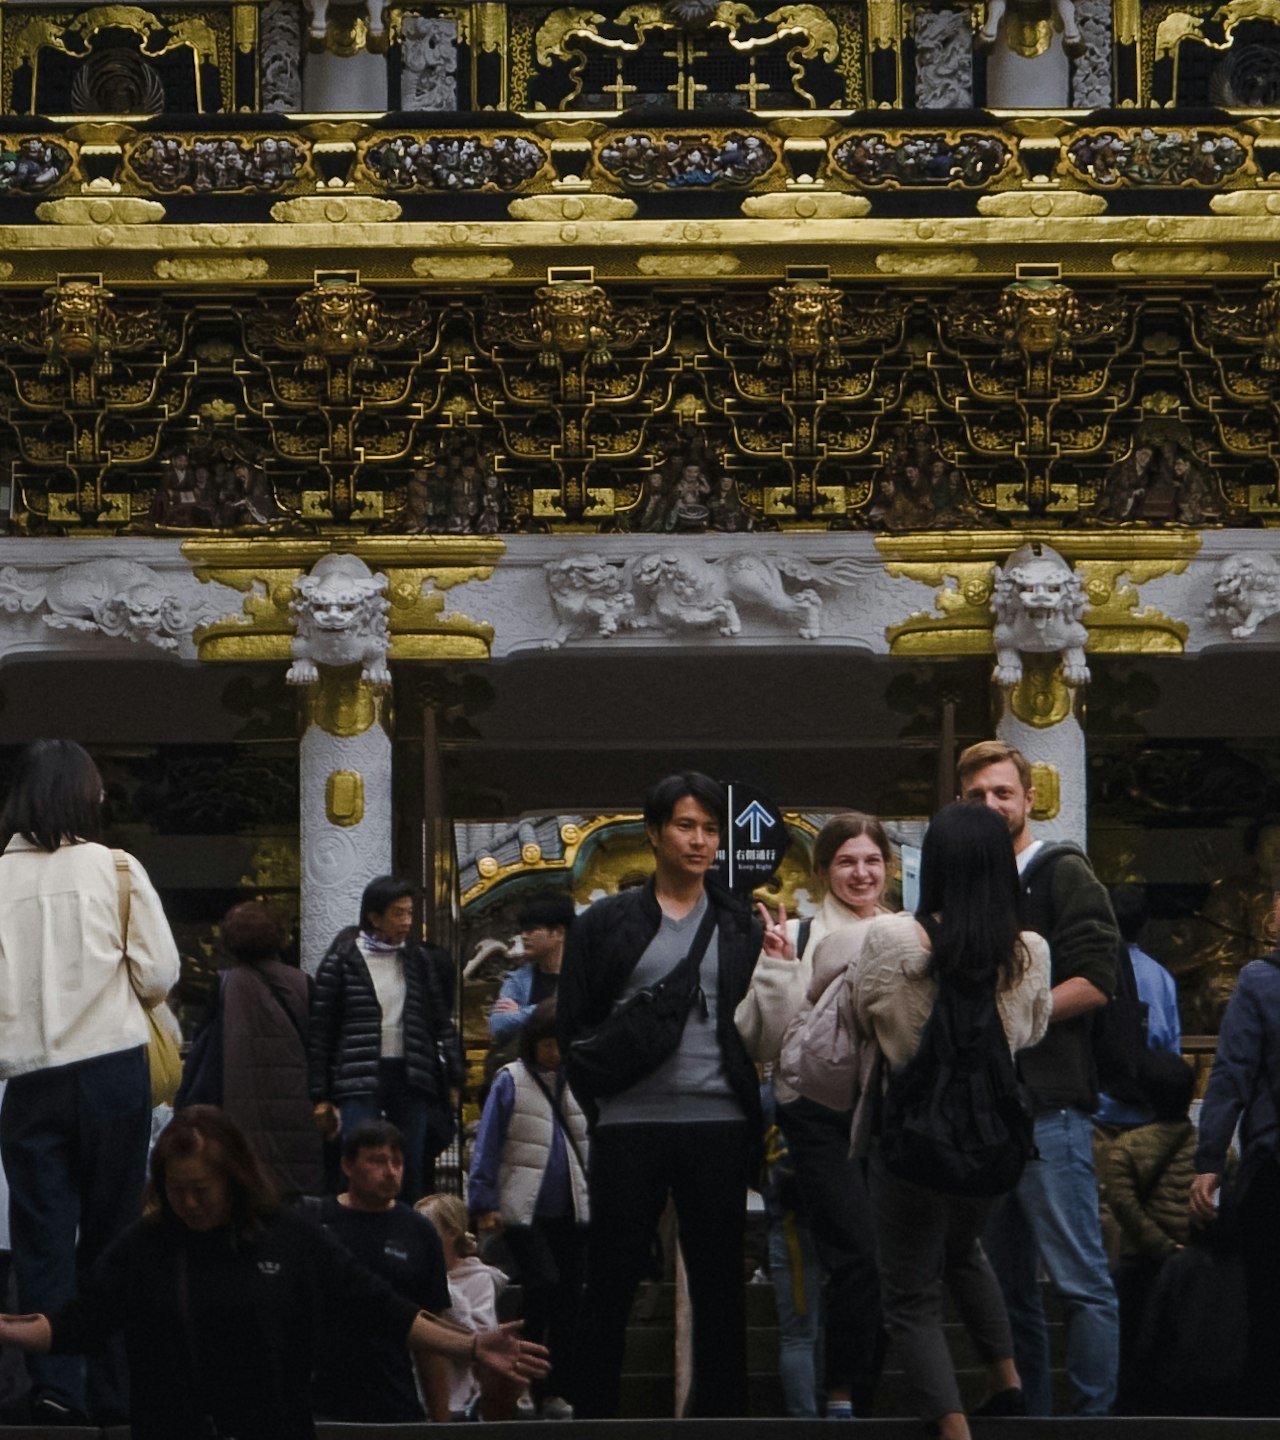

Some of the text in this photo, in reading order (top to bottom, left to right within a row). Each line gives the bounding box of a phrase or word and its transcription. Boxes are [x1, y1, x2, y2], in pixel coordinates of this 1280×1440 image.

[736, 849, 776, 861] 右側通行
[738, 863, 772, 871] Keep Right
